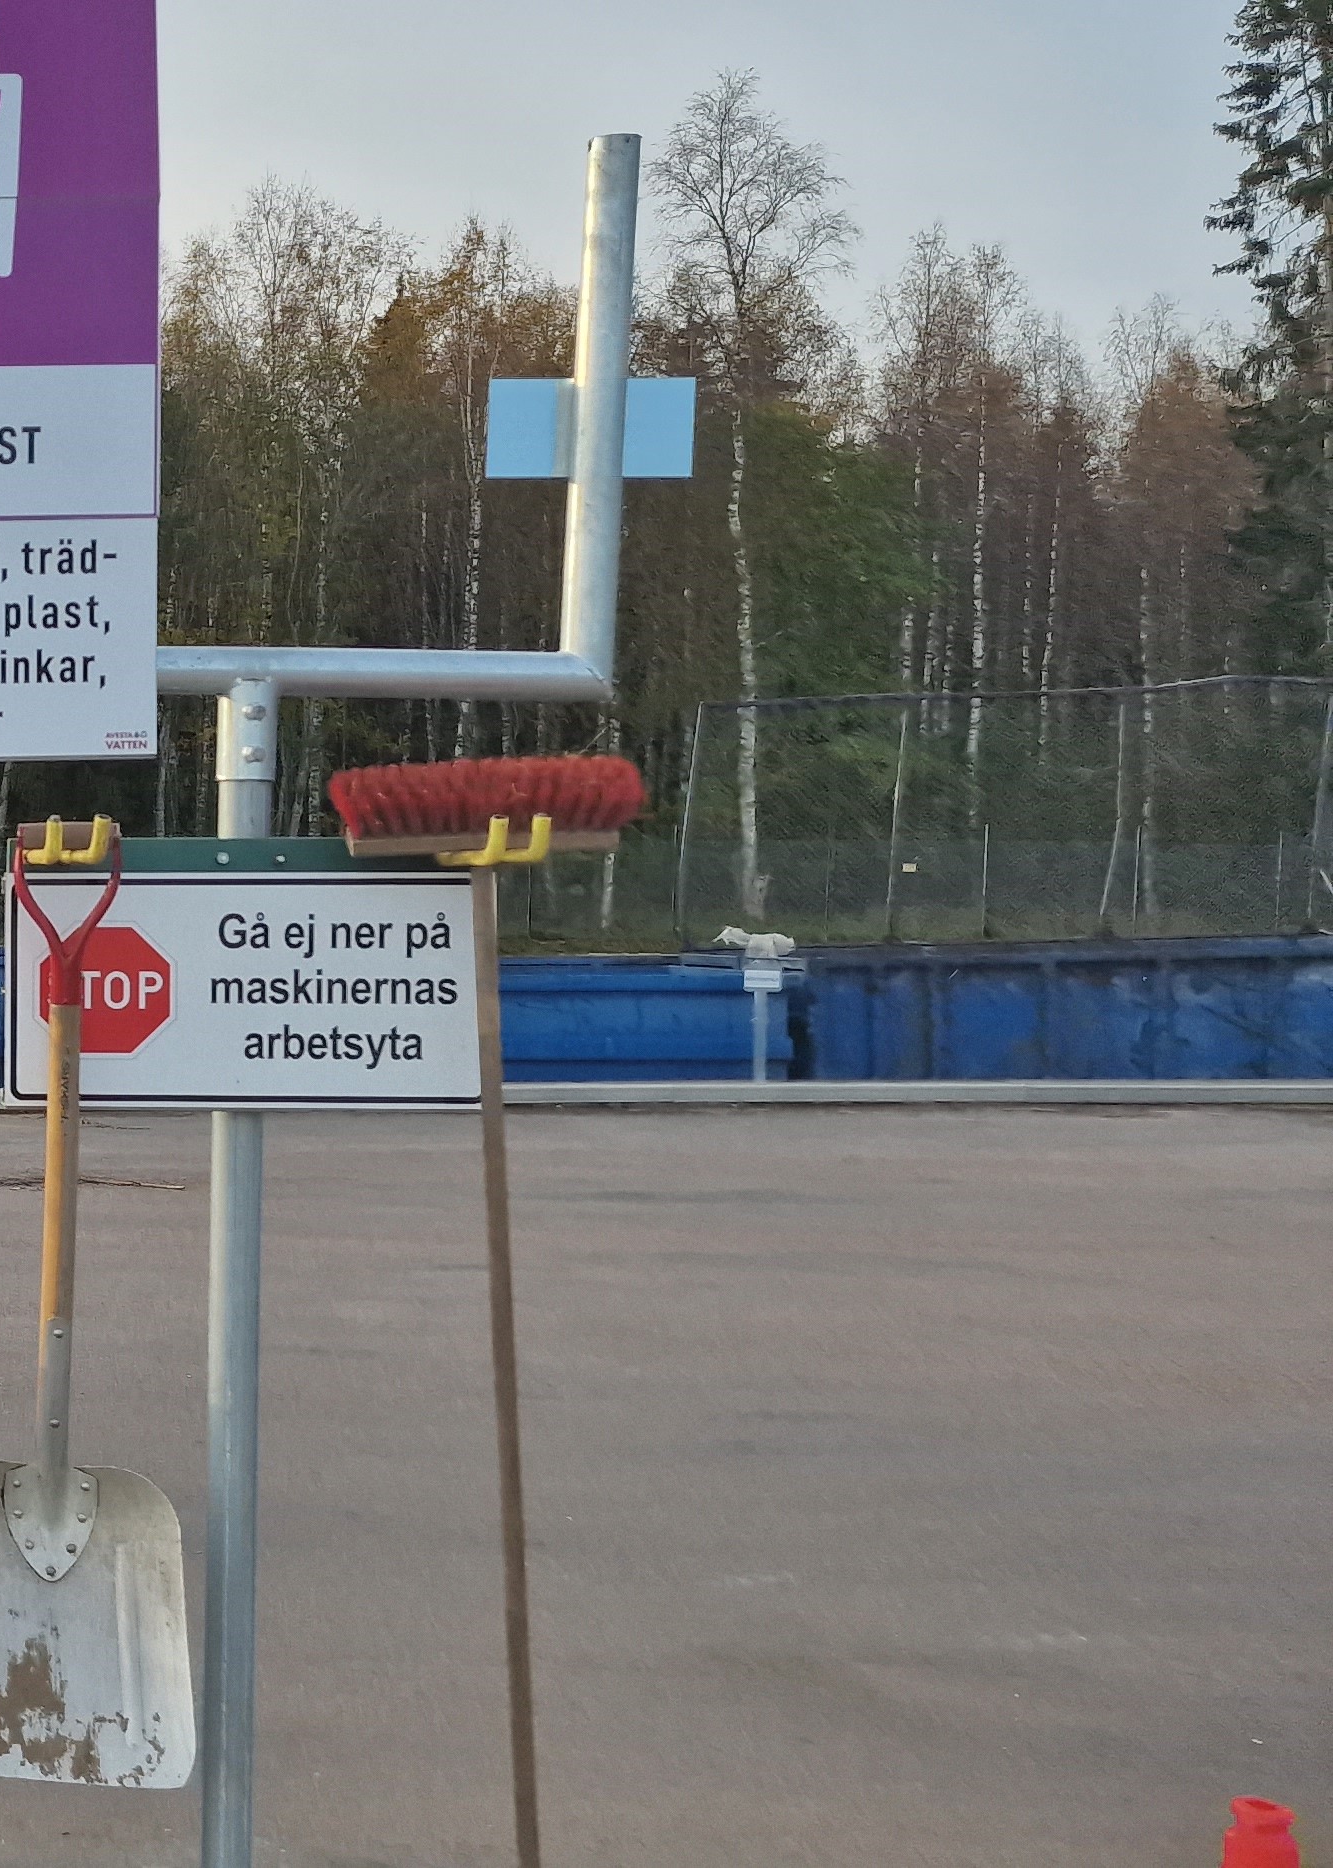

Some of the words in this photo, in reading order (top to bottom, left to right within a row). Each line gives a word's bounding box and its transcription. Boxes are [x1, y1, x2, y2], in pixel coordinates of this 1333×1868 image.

[20, 538, 118, 575] träd-
[4, 594, 110, 638] plast,
[105, 740, 147, 750] VATTEN
[218, 911, 270, 949] Gå
[284, 913, 315, 959] ej
[331, 922, 393, 950] ner
[406, 911, 452, 959] på
[47, 970, 164, 1010] TOP
[210, 968, 459, 1005] maskinernas
[244, 1024, 423, 1070] arbetsyta
